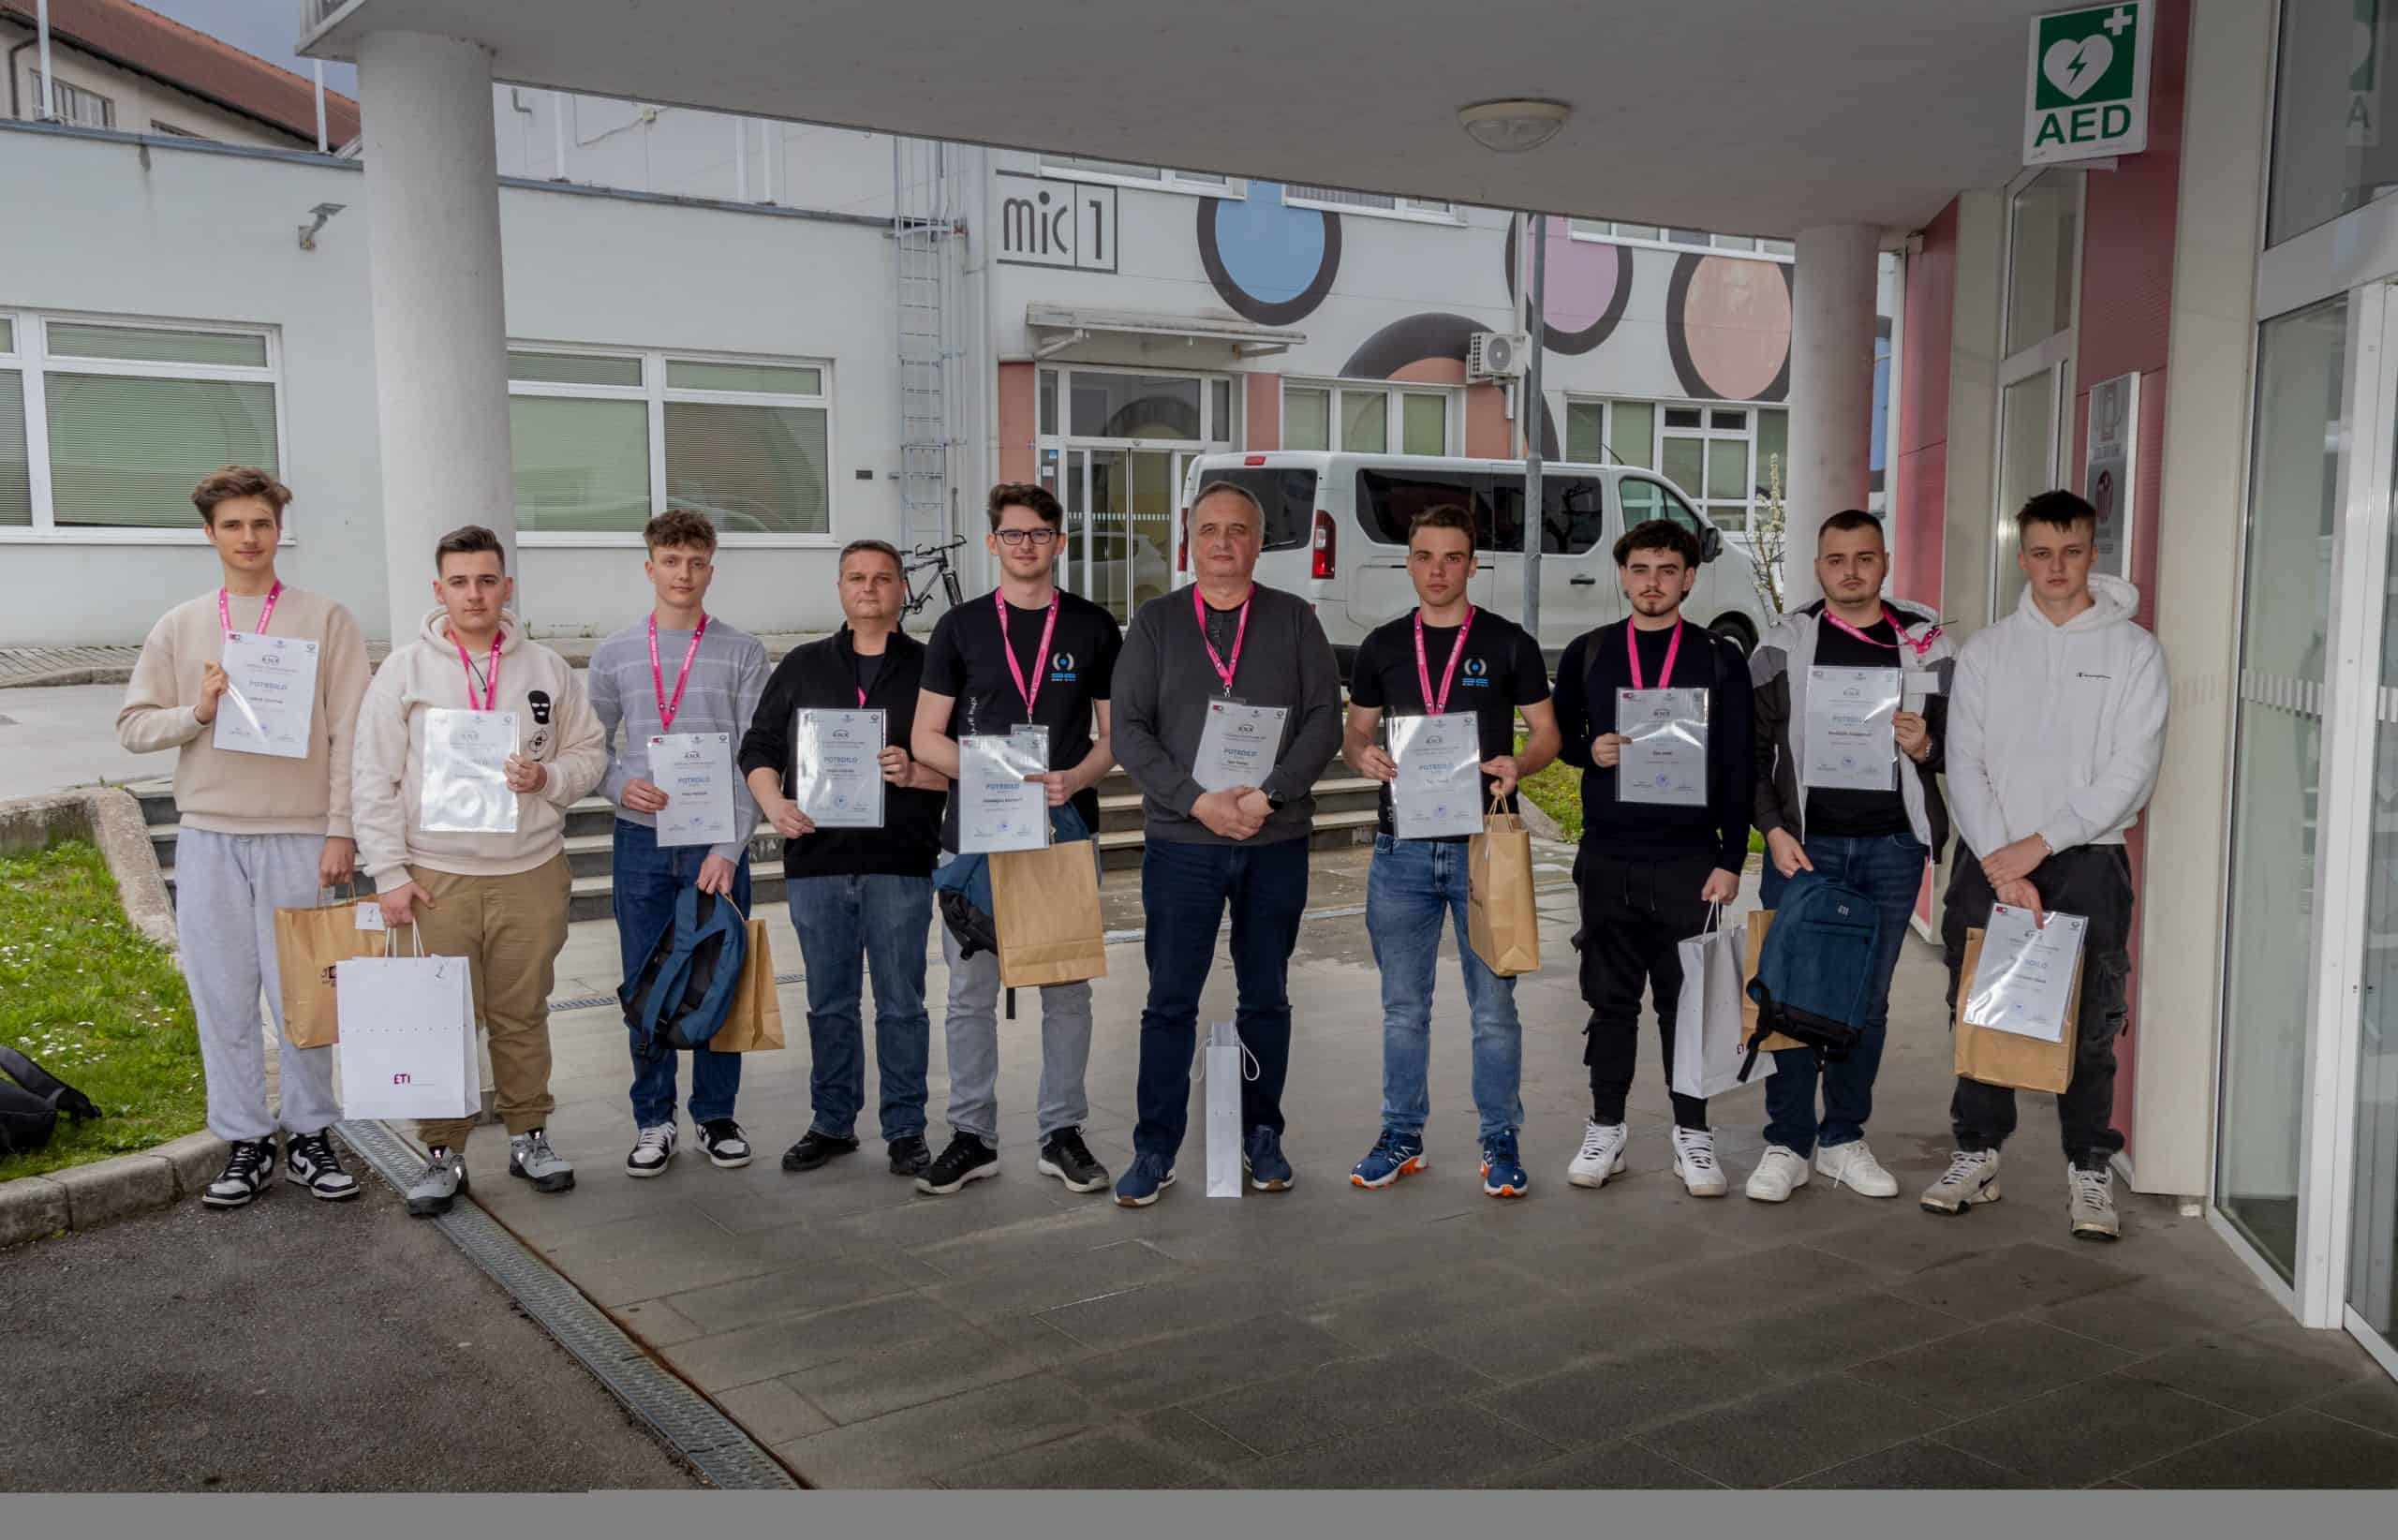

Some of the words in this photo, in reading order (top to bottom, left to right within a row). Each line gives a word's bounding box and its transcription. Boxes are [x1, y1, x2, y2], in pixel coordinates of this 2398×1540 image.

[2034, 104, 2131, 148] AED
[1003, 190, 1069, 255] mic
[1089, 200, 1103, 259] 1
[393, 1073, 411, 1085] ETI
